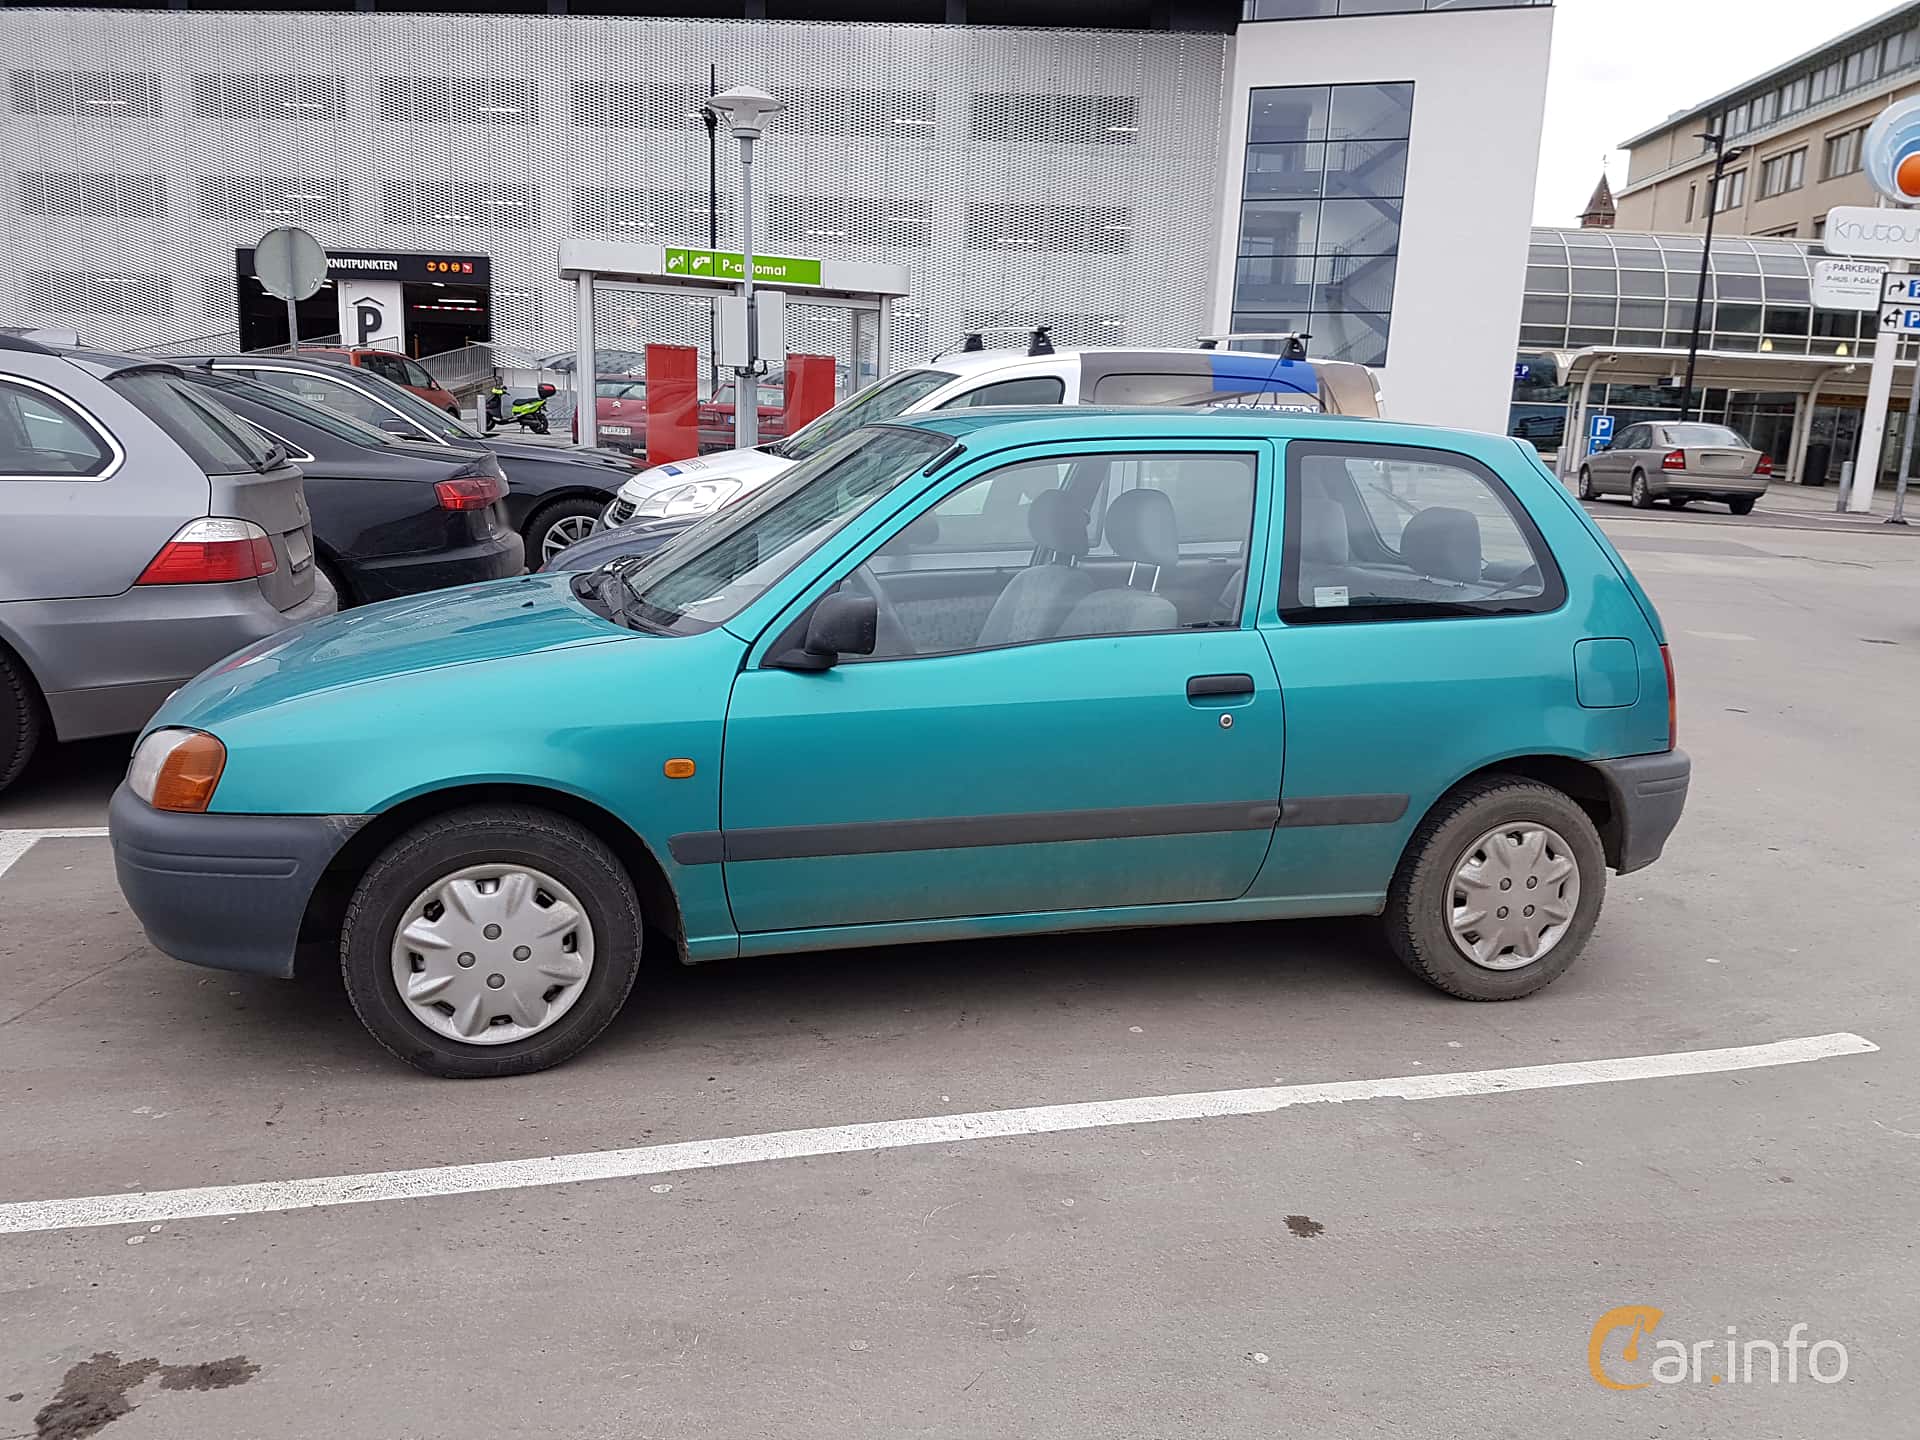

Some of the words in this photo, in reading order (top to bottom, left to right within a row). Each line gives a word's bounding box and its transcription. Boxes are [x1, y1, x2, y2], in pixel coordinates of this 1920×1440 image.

[327, 258, 398, 271] KNUTPUNKTEN
[722, 259, 786, 276] P-atomat
[1596, 418, 1610, 436] P
